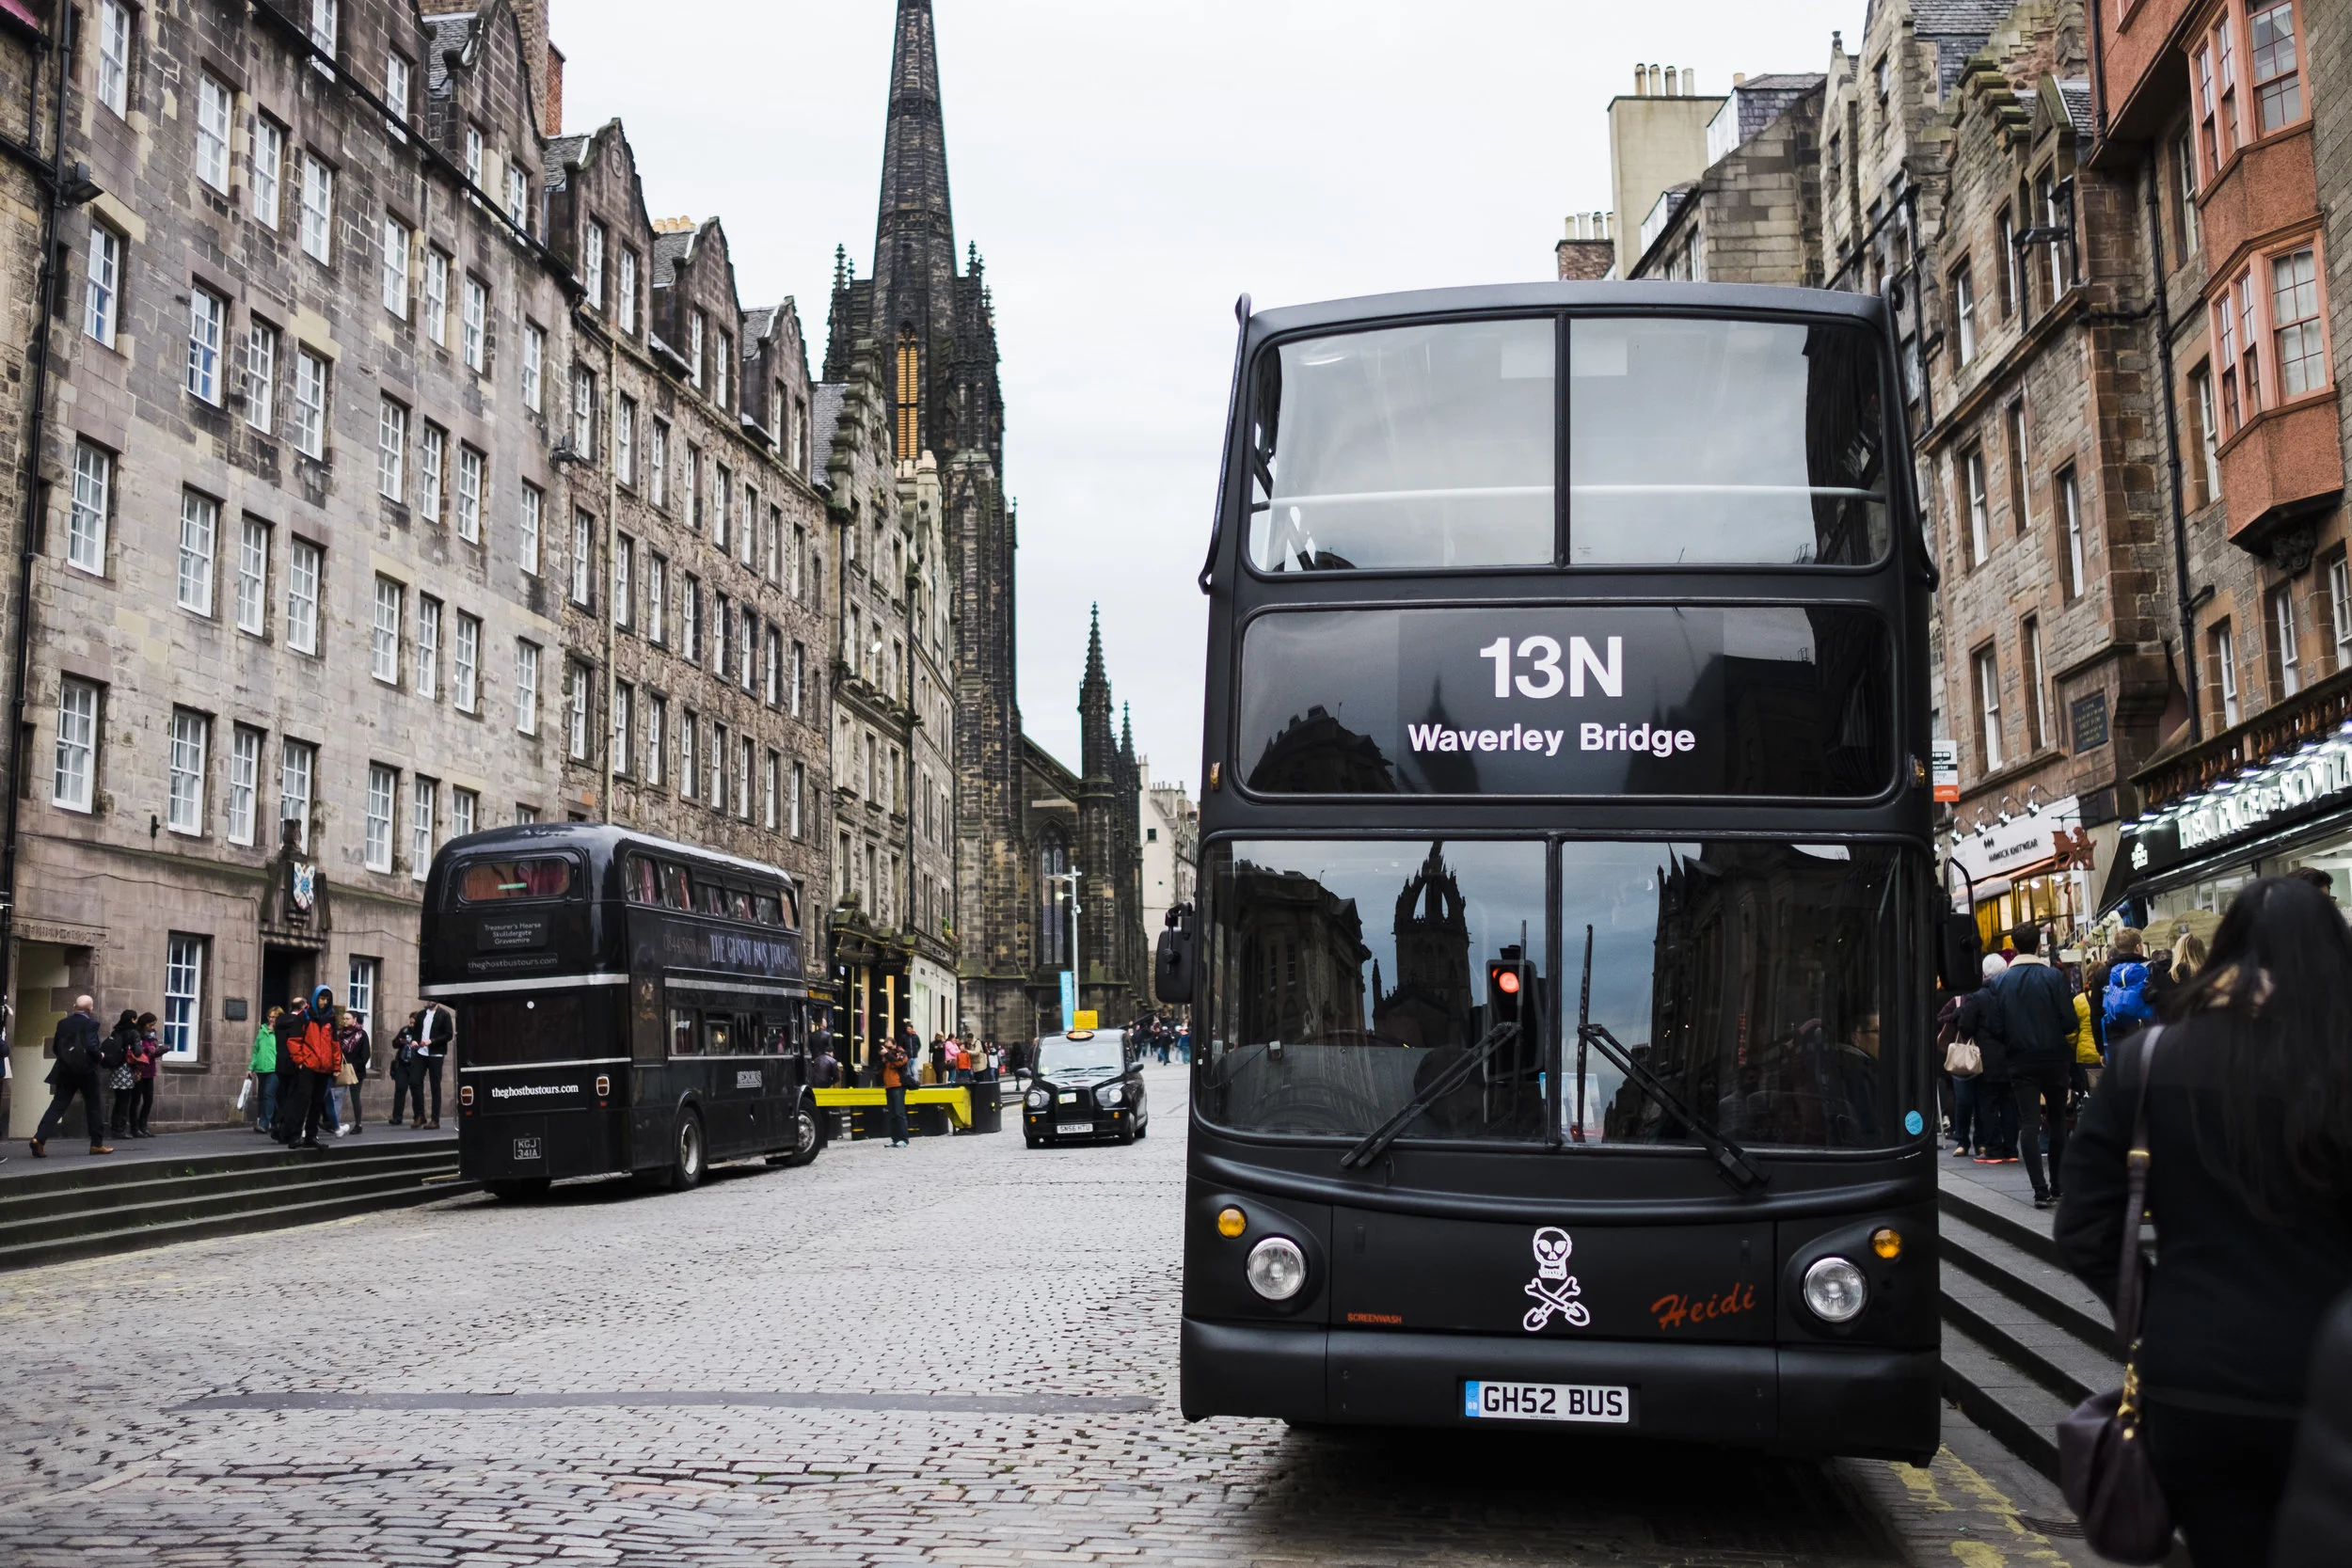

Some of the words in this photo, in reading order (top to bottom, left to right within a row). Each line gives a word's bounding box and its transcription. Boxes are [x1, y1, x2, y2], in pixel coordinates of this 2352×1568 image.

[1480, 635, 1623, 699] 13N
[1407, 722, 1564, 756] Waverley
[1580, 722, 1696, 758] Bridge
[1988, 849, 2010, 863] HAWICK
[2010, 838, 2039, 856] KNITWEAR
[484, 923, 518, 931] Treasurer's
[709, 934, 726, 963] THE
[727, 936, 752, 965] GHOST
[754, 941, 769, 968] BUS
[468, 958, 558, 971] theghostbustours.com
[491, 1085, 580, 1099] theghostbustours.com
[517, 1139, 537, 1148] KGJ
[517, 1148, 538, 1158] 341A
[1649, 1281, 1756, 1331] Heidi
[1347, 1312, 1403, 1323] SCREENWASH
[1484, 1386, 1556, 1415] GH52
[1568, 1388, 1623, 1417] BUS
